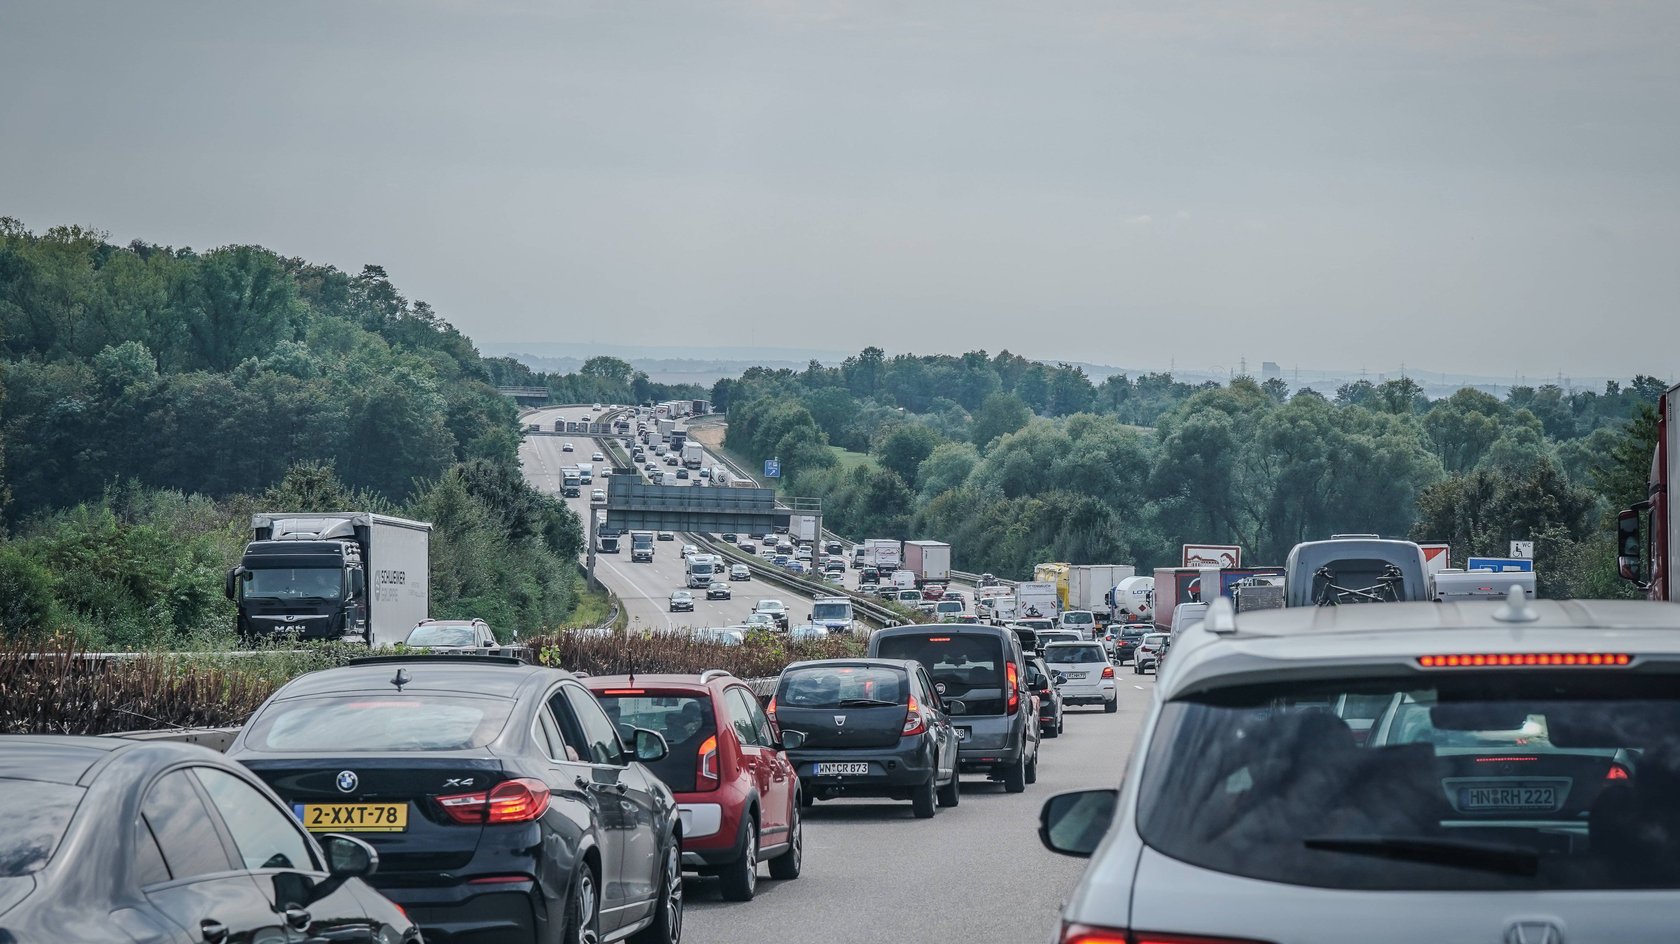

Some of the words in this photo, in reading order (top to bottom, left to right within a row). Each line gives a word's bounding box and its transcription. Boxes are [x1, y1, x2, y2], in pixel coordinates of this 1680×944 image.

[850, 763, 867, 773] 873
[442, 777, 474, 787] X4
[1524, 790, 1553, 804] 222
[312, 807, 398, 824] 2-XXT-78
